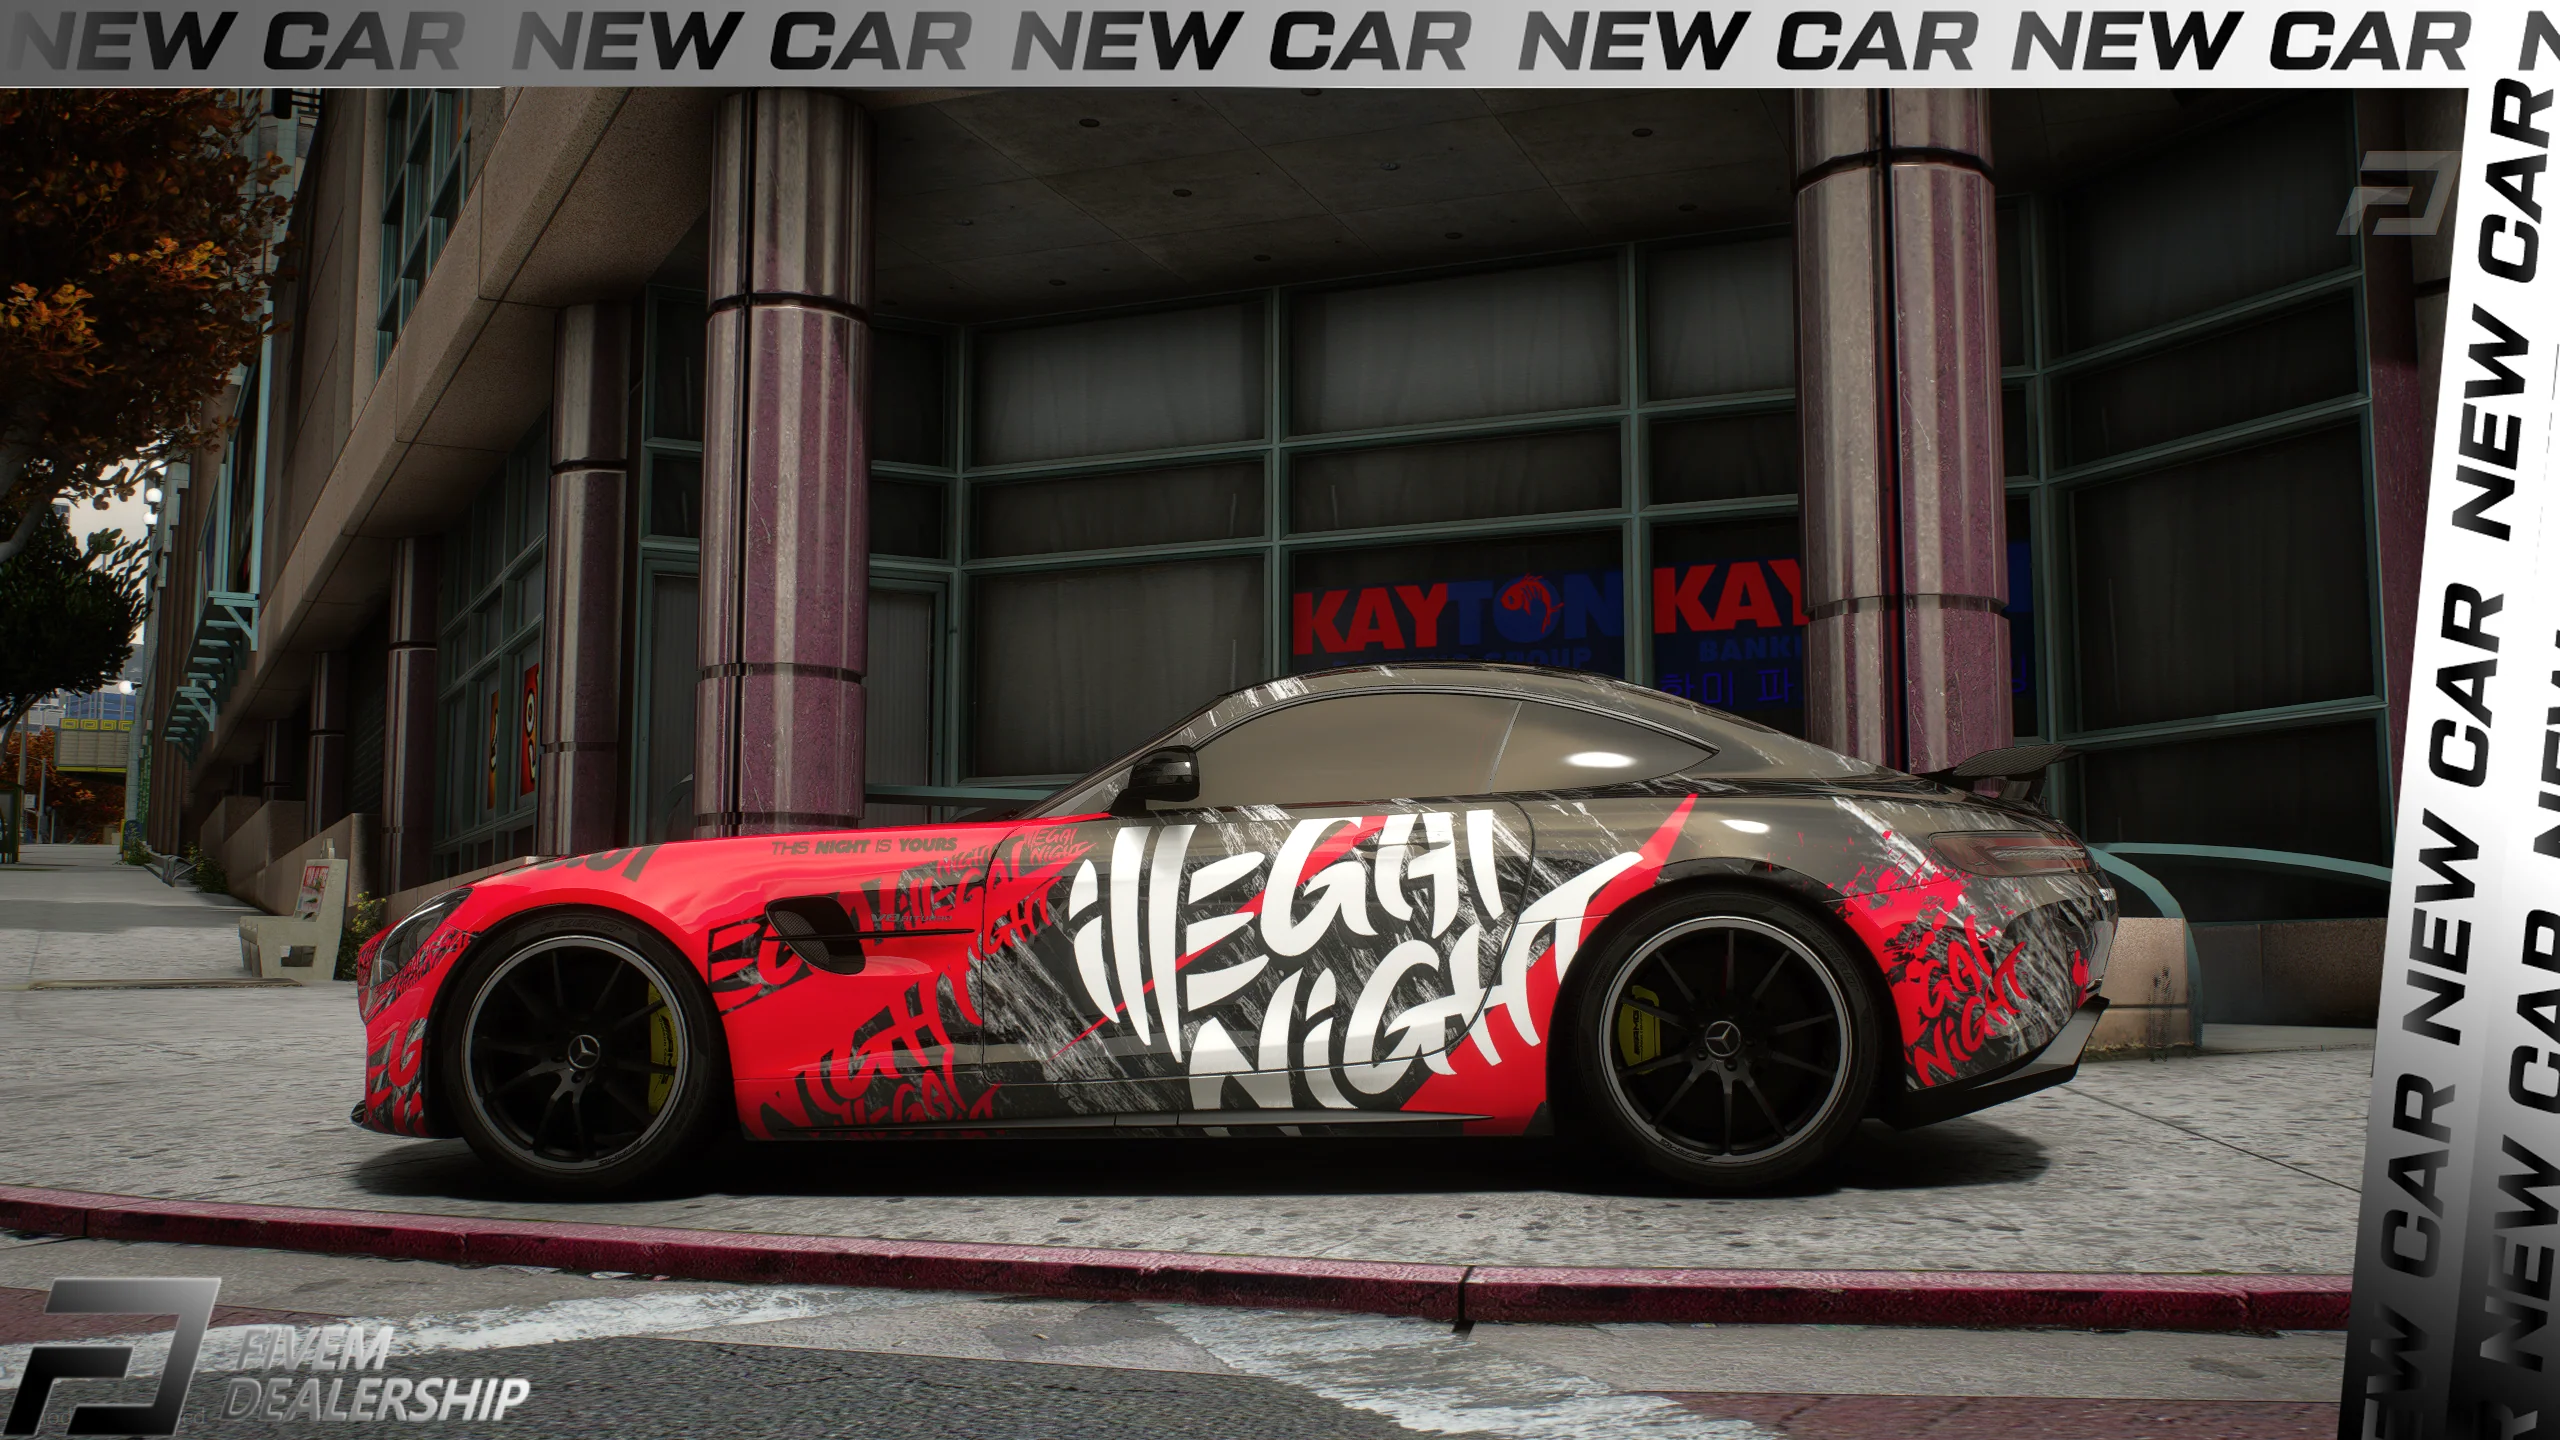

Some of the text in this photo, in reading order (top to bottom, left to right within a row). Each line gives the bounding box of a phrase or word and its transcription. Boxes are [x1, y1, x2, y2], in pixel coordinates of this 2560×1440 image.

[771, 837, 958, 856] THIS NIGHT IS YOURS
[870, 913, 900, 922] V8
